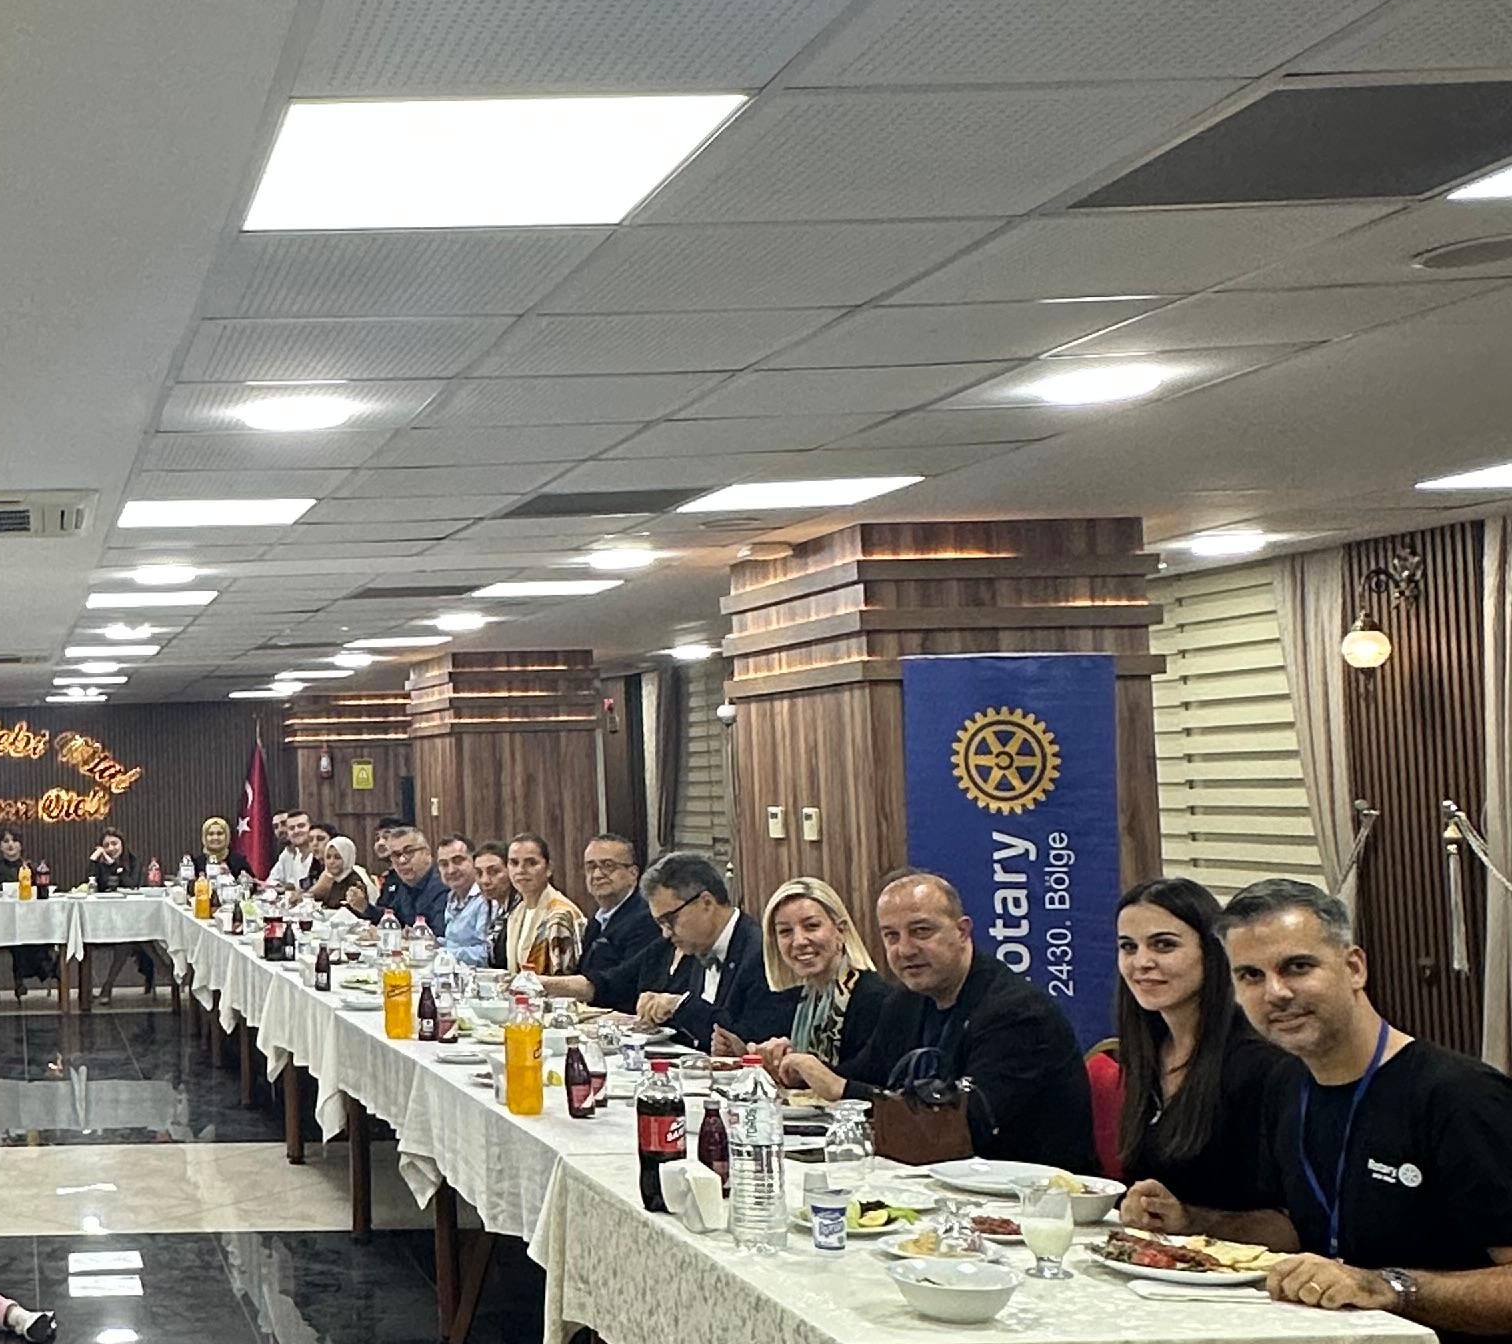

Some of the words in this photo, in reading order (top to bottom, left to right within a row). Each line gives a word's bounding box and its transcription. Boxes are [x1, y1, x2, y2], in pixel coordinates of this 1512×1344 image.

[989, 831, 1038, 982] otary
[1044, 832, 1076, 910] Bölge
[1046, 920, 1075, 998] 2430.
